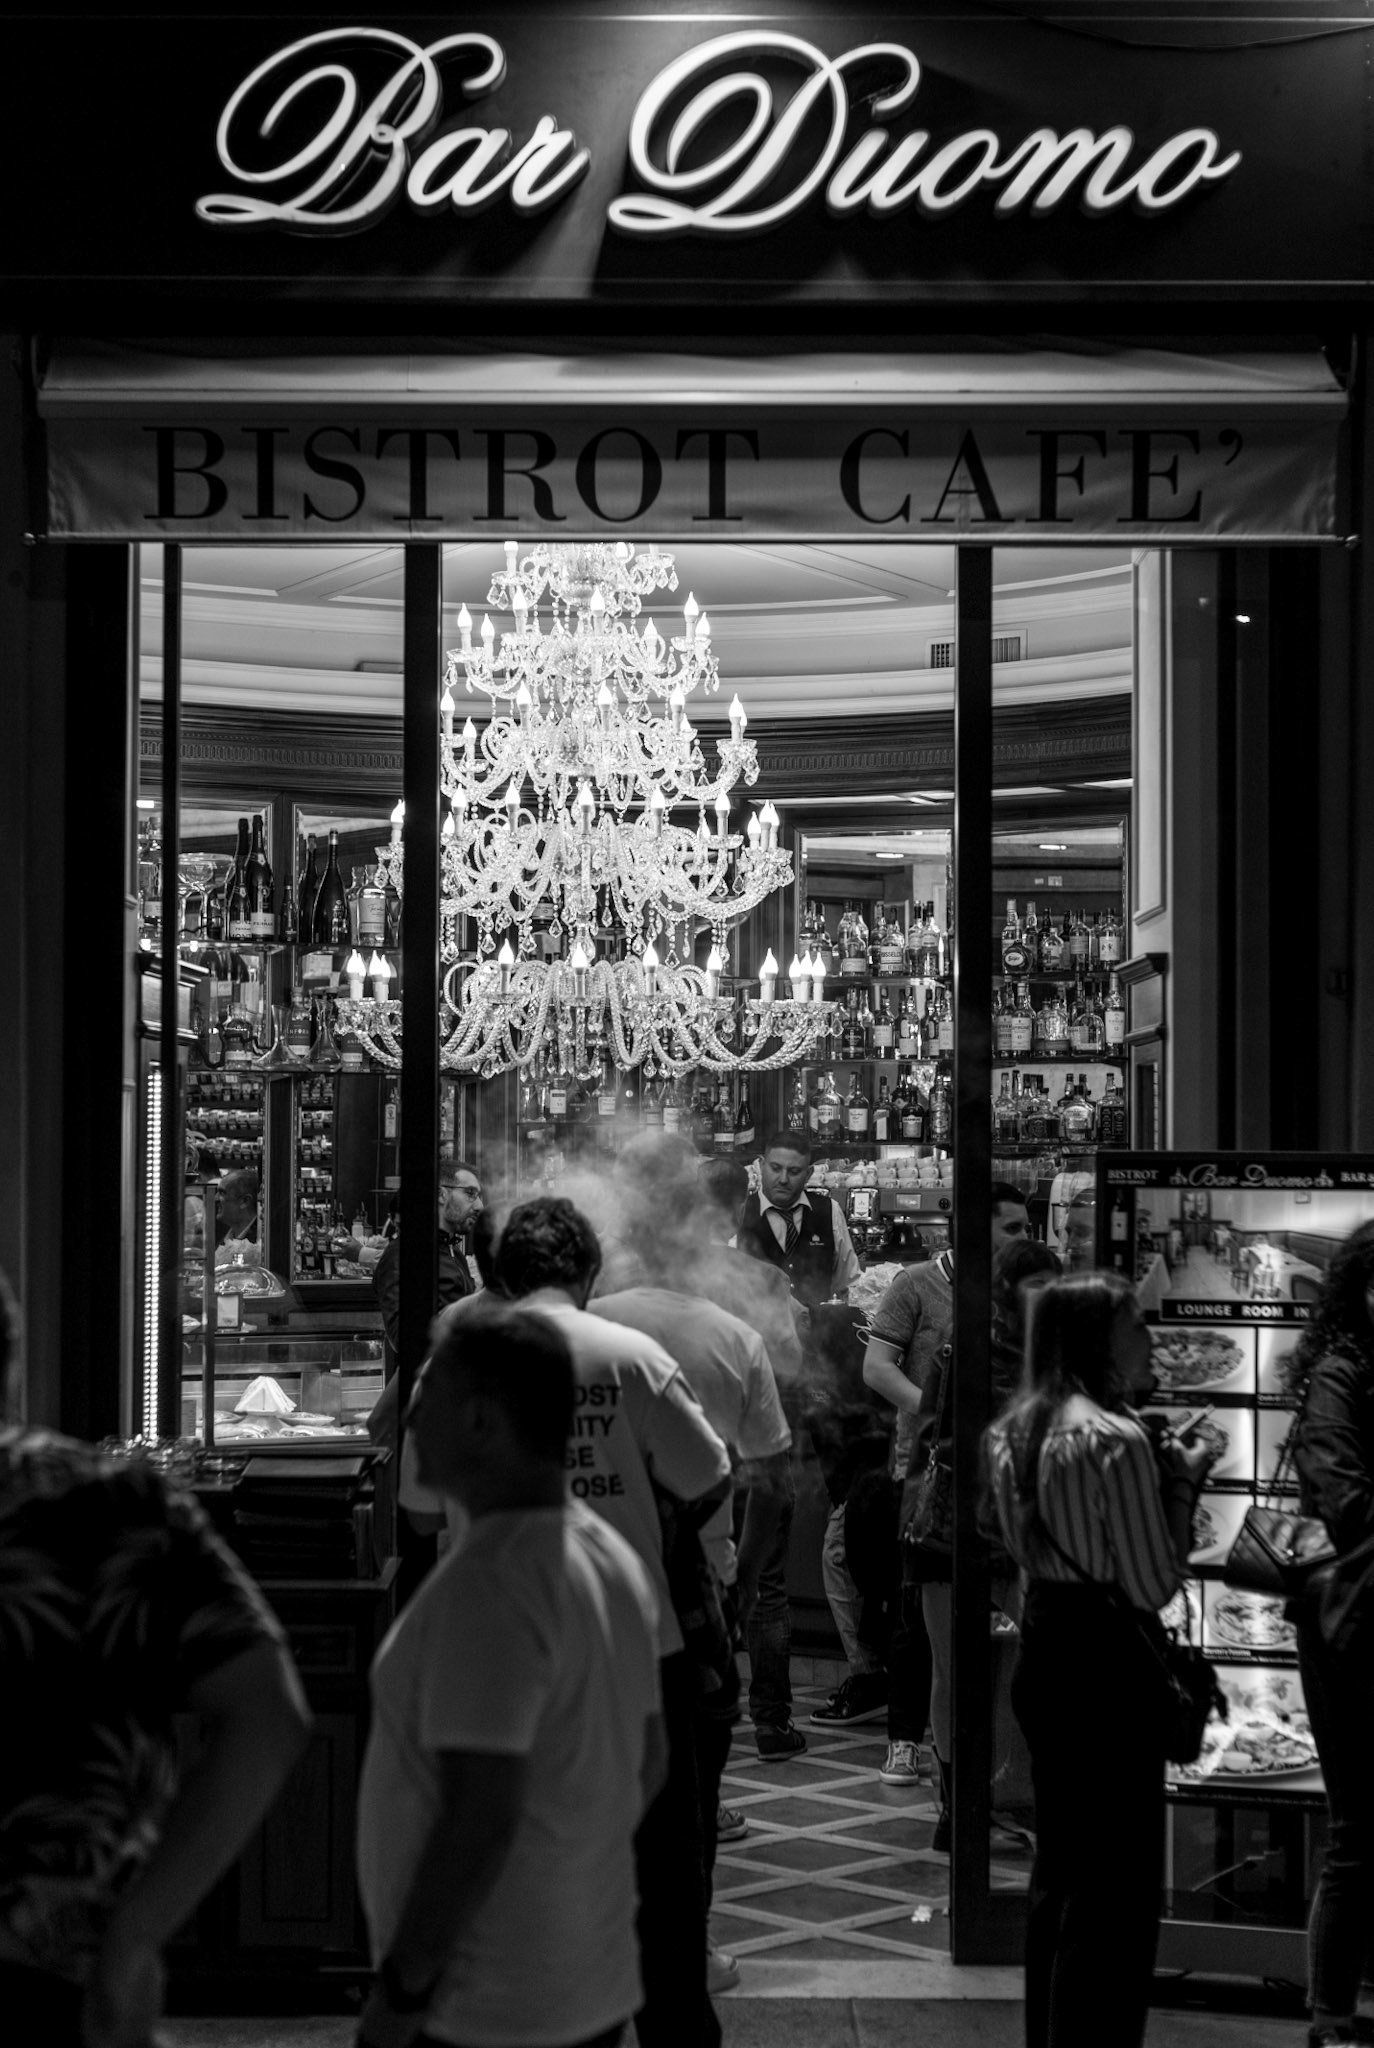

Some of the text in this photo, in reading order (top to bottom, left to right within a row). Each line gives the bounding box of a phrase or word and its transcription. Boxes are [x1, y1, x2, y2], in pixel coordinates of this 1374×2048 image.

[195, 26, 1243, 232] Bar Duomo
[141, 425, 1244, 524] BISTROT CAFE'
[1107, 1169, 1160, 1180] BISTROT
[1188, 1163, 1315, 1188] Bar Duomo
[1176, 1304, 1233, 1317] LOUNGE
[1241, 1304, 1284, 1318] ROOM
